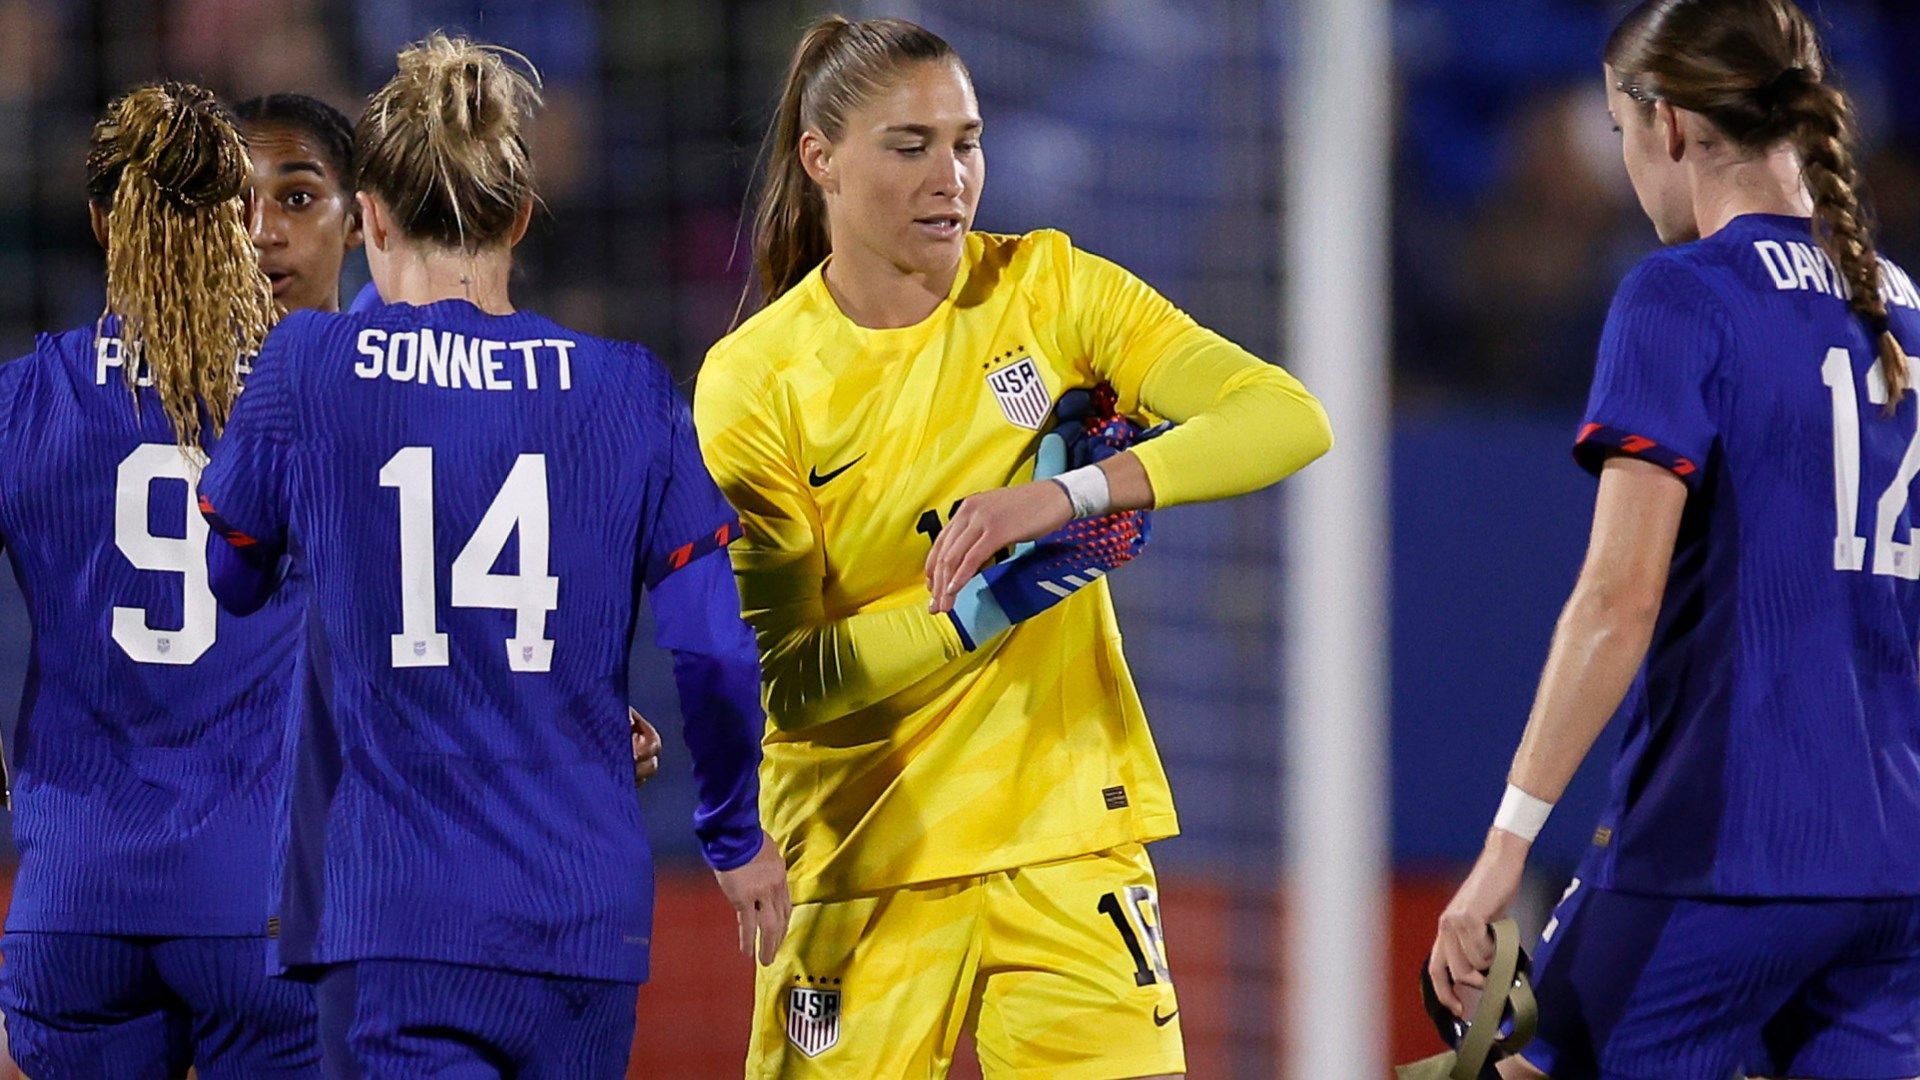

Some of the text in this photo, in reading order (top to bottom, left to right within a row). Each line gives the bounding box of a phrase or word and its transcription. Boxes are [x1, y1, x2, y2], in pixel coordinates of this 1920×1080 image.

[1753, 240, 1920, 310] DAVION
[96, 337, 259, 396] PUE
[355, 328, 576, 390] SONNETT
[991, 362, 1034, 393] USA
[1821, 346, 1920, 580] 12
[111, 443, 217, 665] 9
[379, 446, 559, 672] 14
[793, 991, 838, 1019] USA
